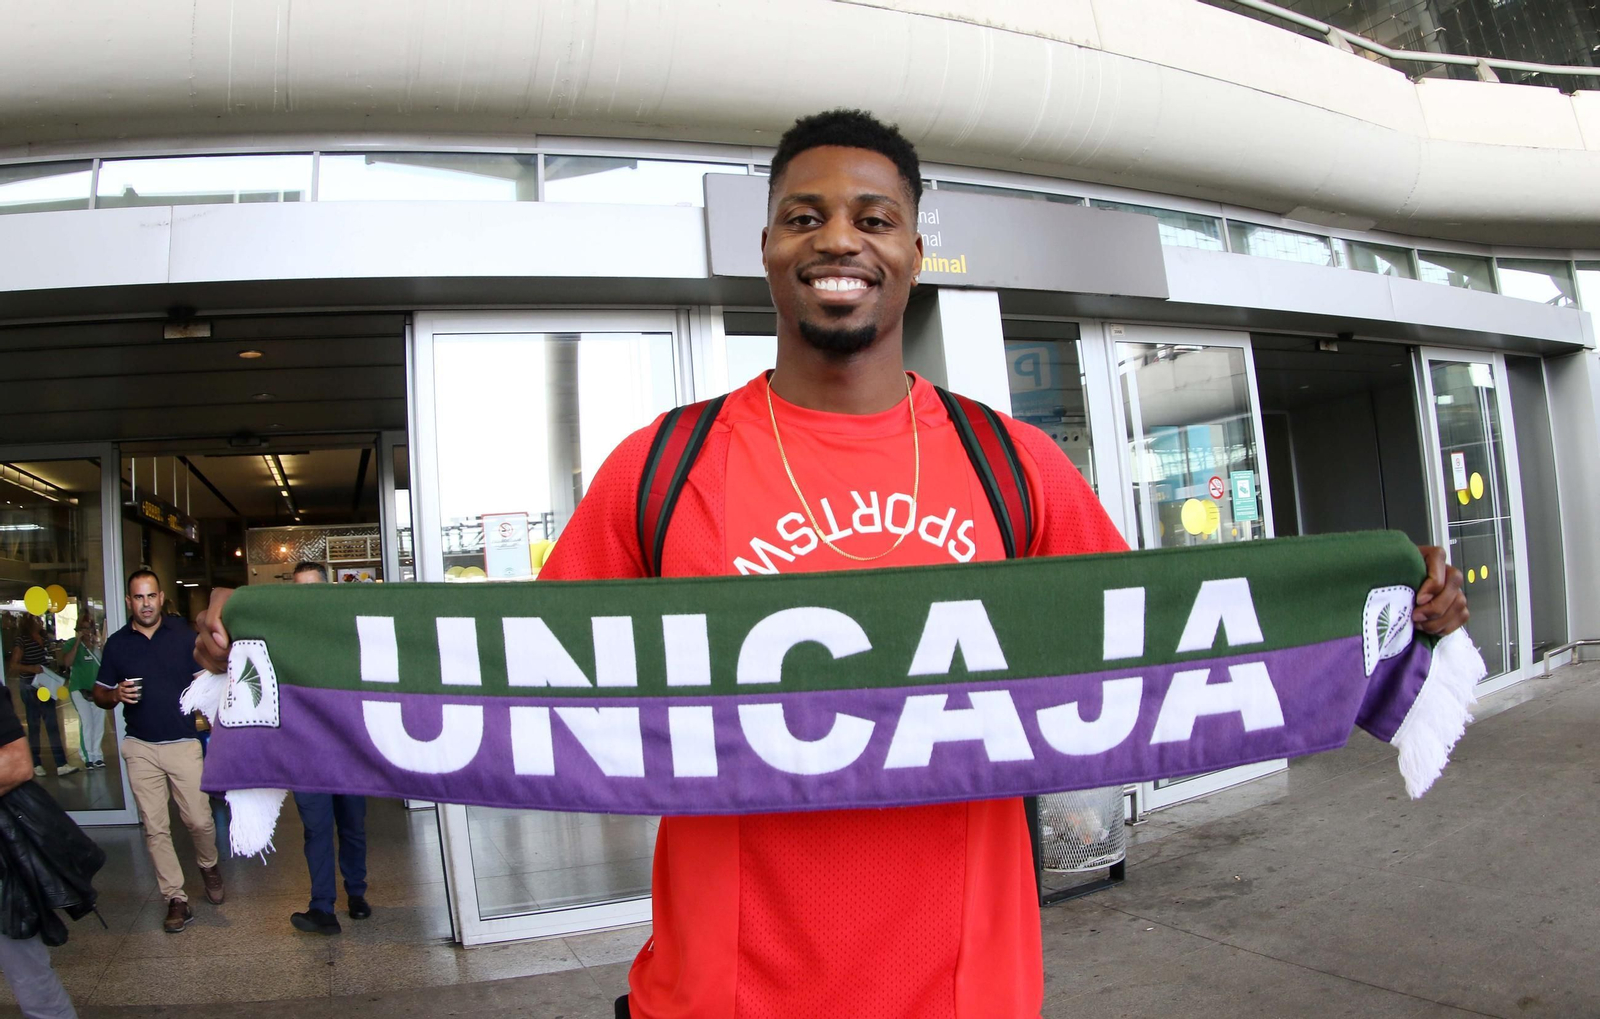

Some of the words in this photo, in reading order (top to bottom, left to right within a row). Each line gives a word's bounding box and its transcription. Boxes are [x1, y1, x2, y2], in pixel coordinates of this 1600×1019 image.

[919, 208, 940, 225] nal
[918, 230, 942, 247] nal
[356, 576, 1285, 778] UNICAJA
